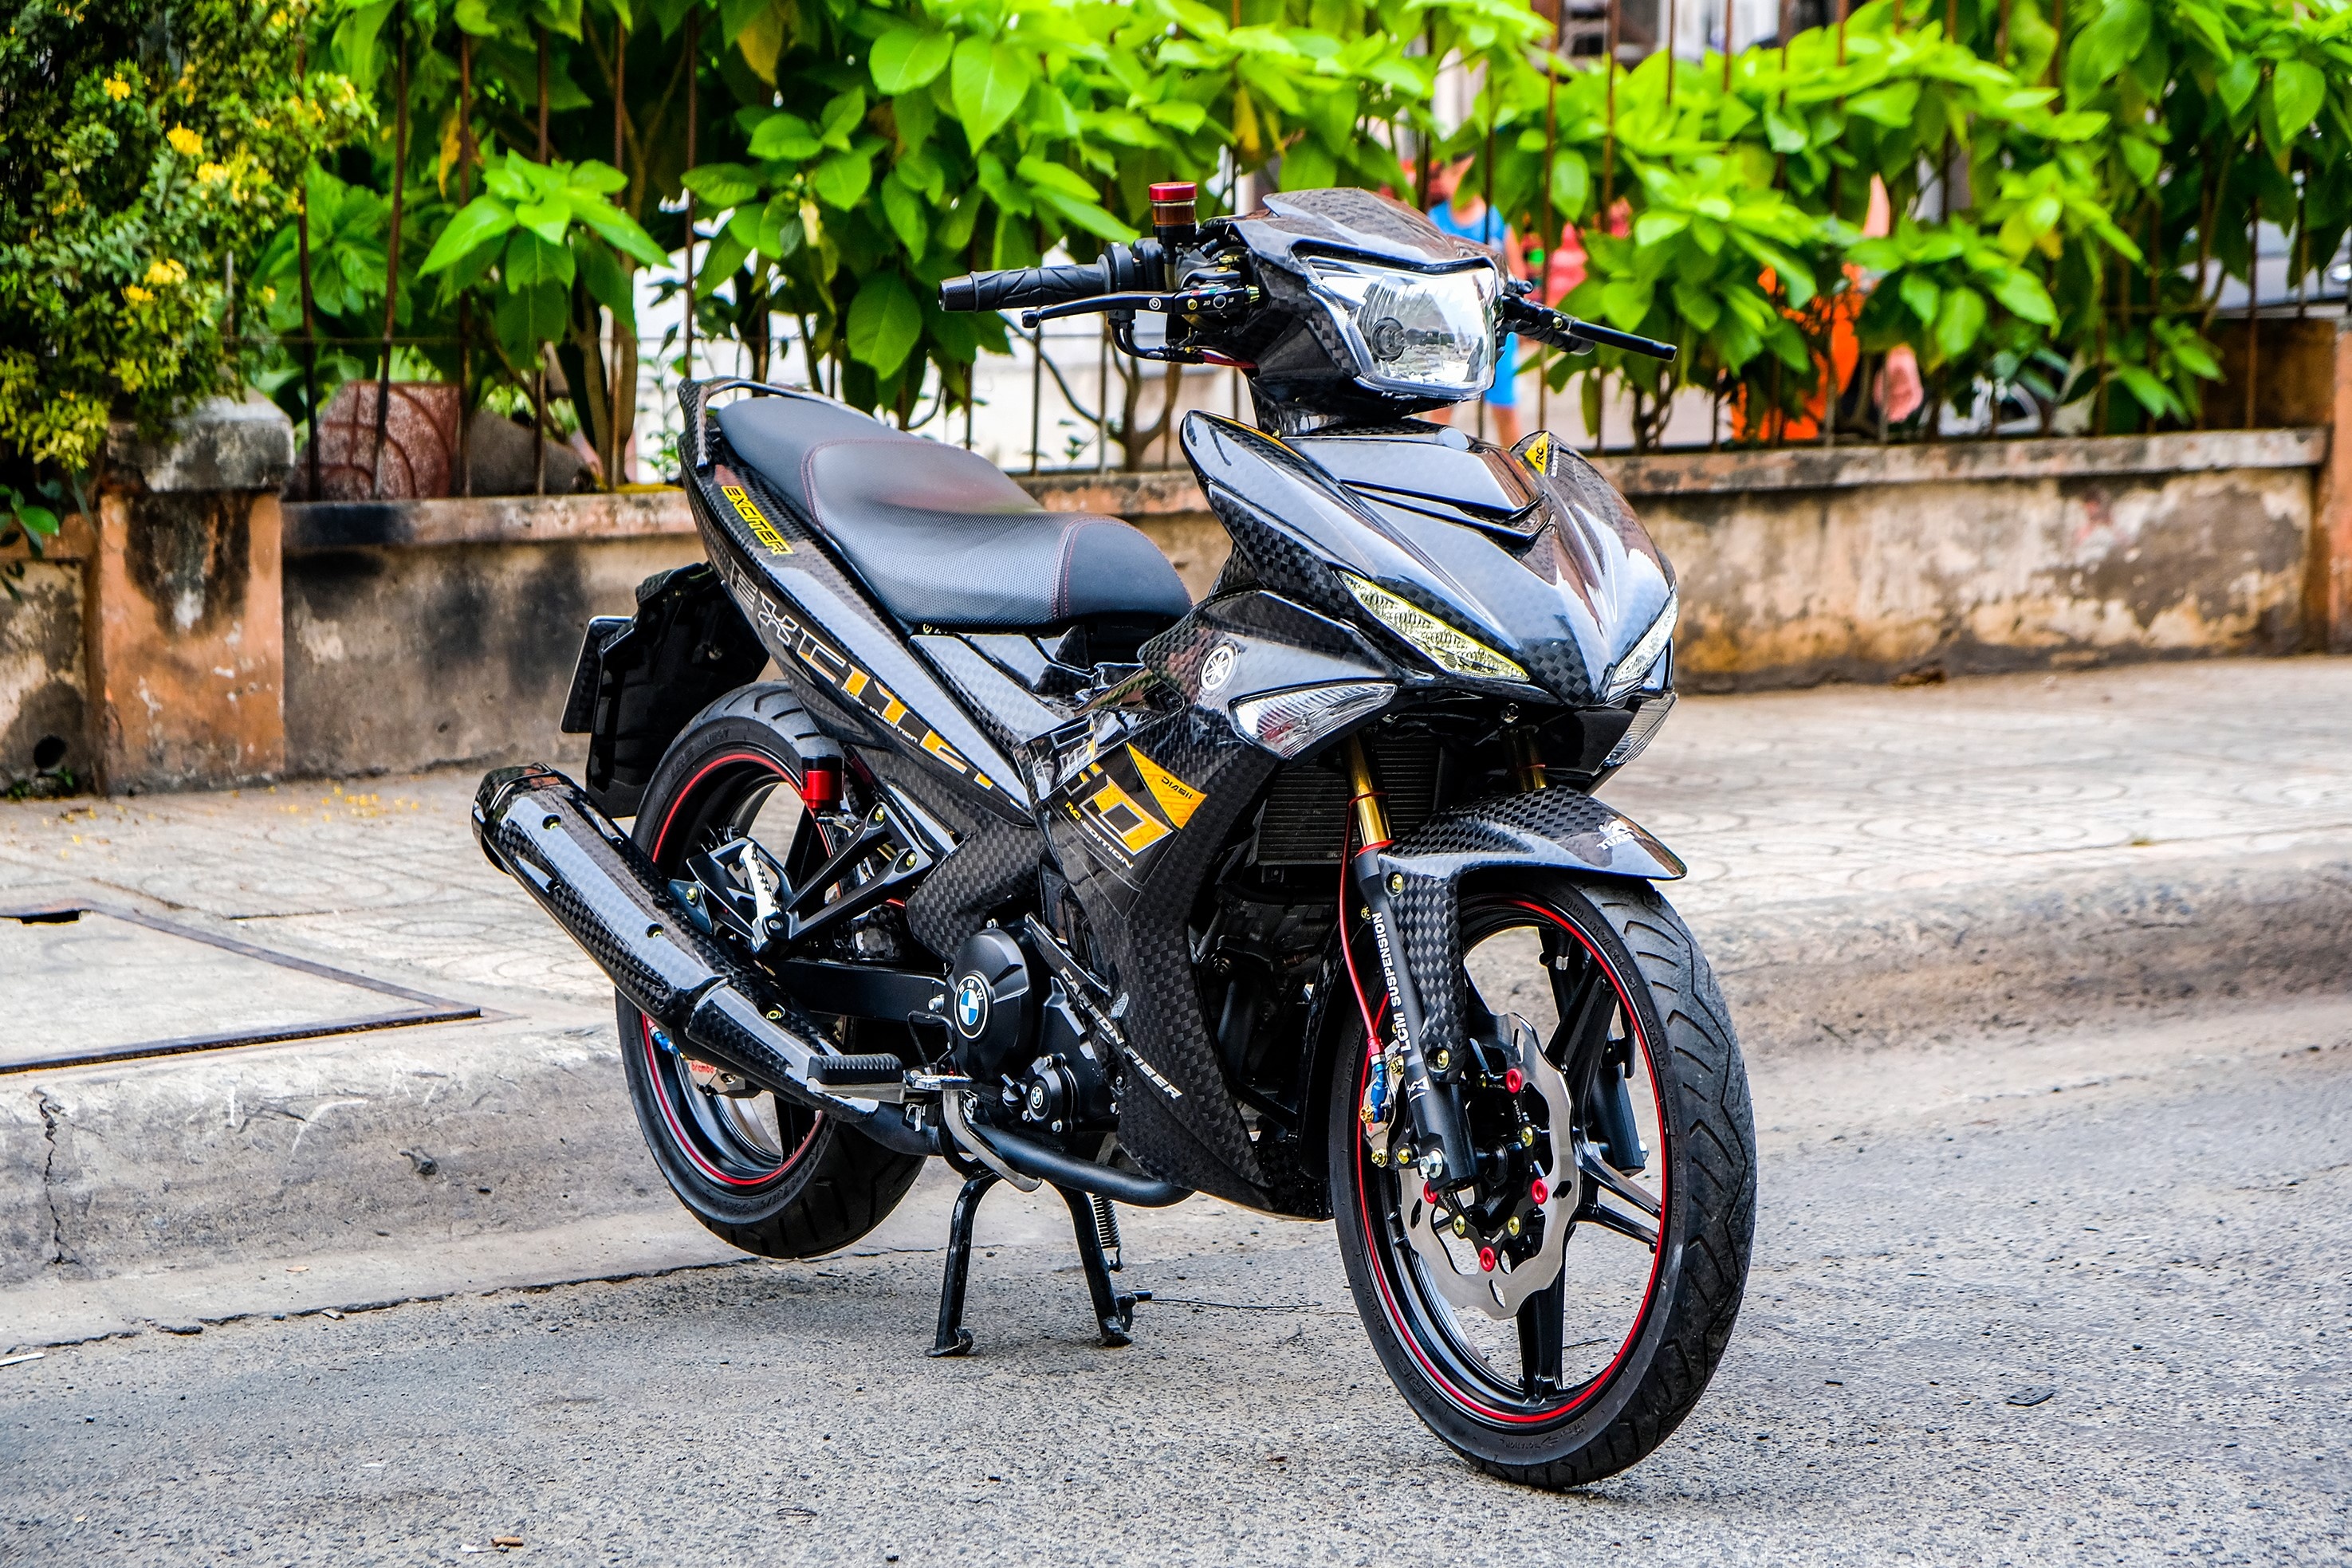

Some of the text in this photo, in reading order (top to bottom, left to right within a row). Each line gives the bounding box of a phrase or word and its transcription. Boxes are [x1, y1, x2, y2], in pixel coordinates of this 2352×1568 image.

[722, 485, 794, 556] EXCITER
[868, 705, 918, 744] INJECTION
[958, 979, 984, 1000] BMW
[1371, 911, 1412, 1052] LCM SUSPENSION
[1123, 1045, 1183, 1100] FIBER
